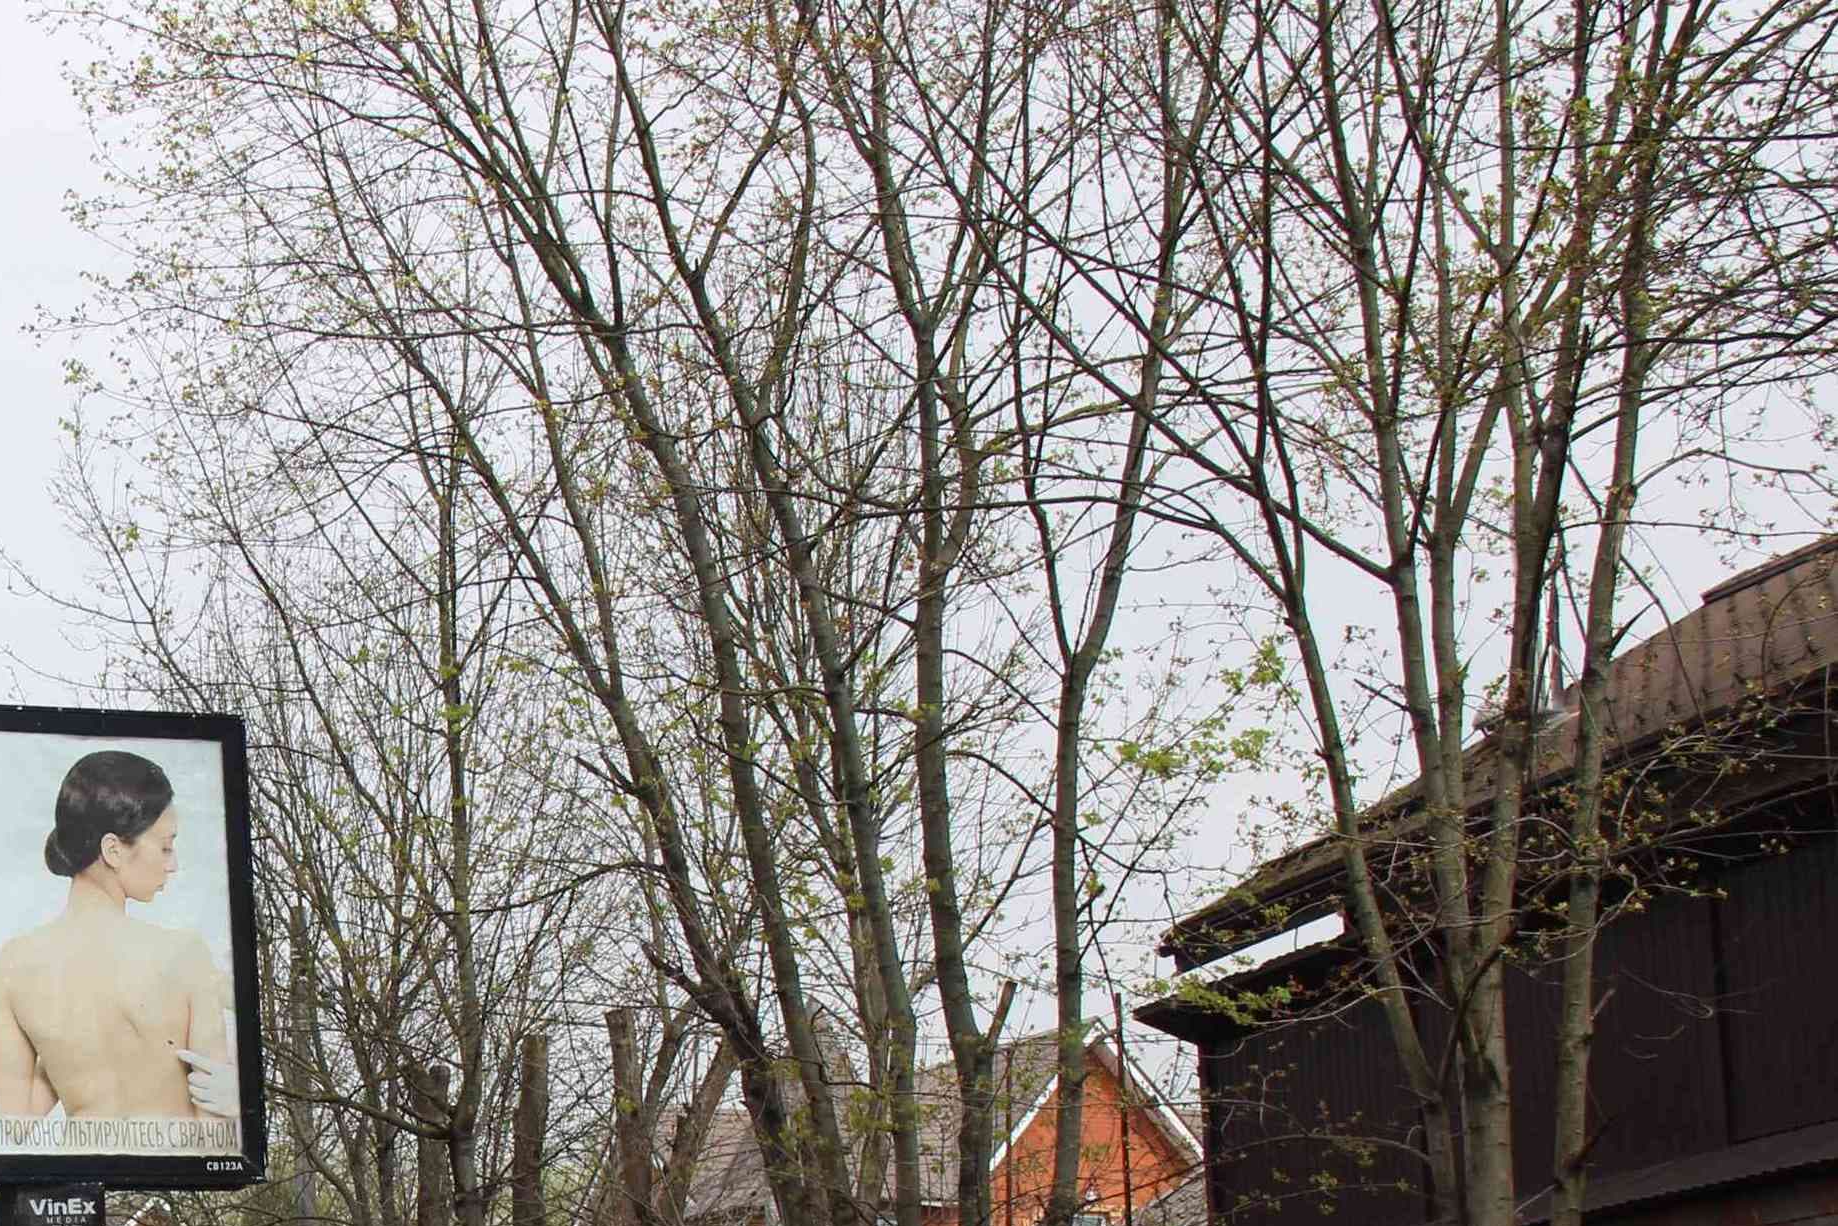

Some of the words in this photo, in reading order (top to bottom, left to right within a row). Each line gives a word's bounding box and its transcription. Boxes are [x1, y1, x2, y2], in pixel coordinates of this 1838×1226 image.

[168, 1121, 177, 1147] С
[180, 1120, 238, 1149] ВРАЧОМ
[29, 1198, 96, 1215] VinEx
